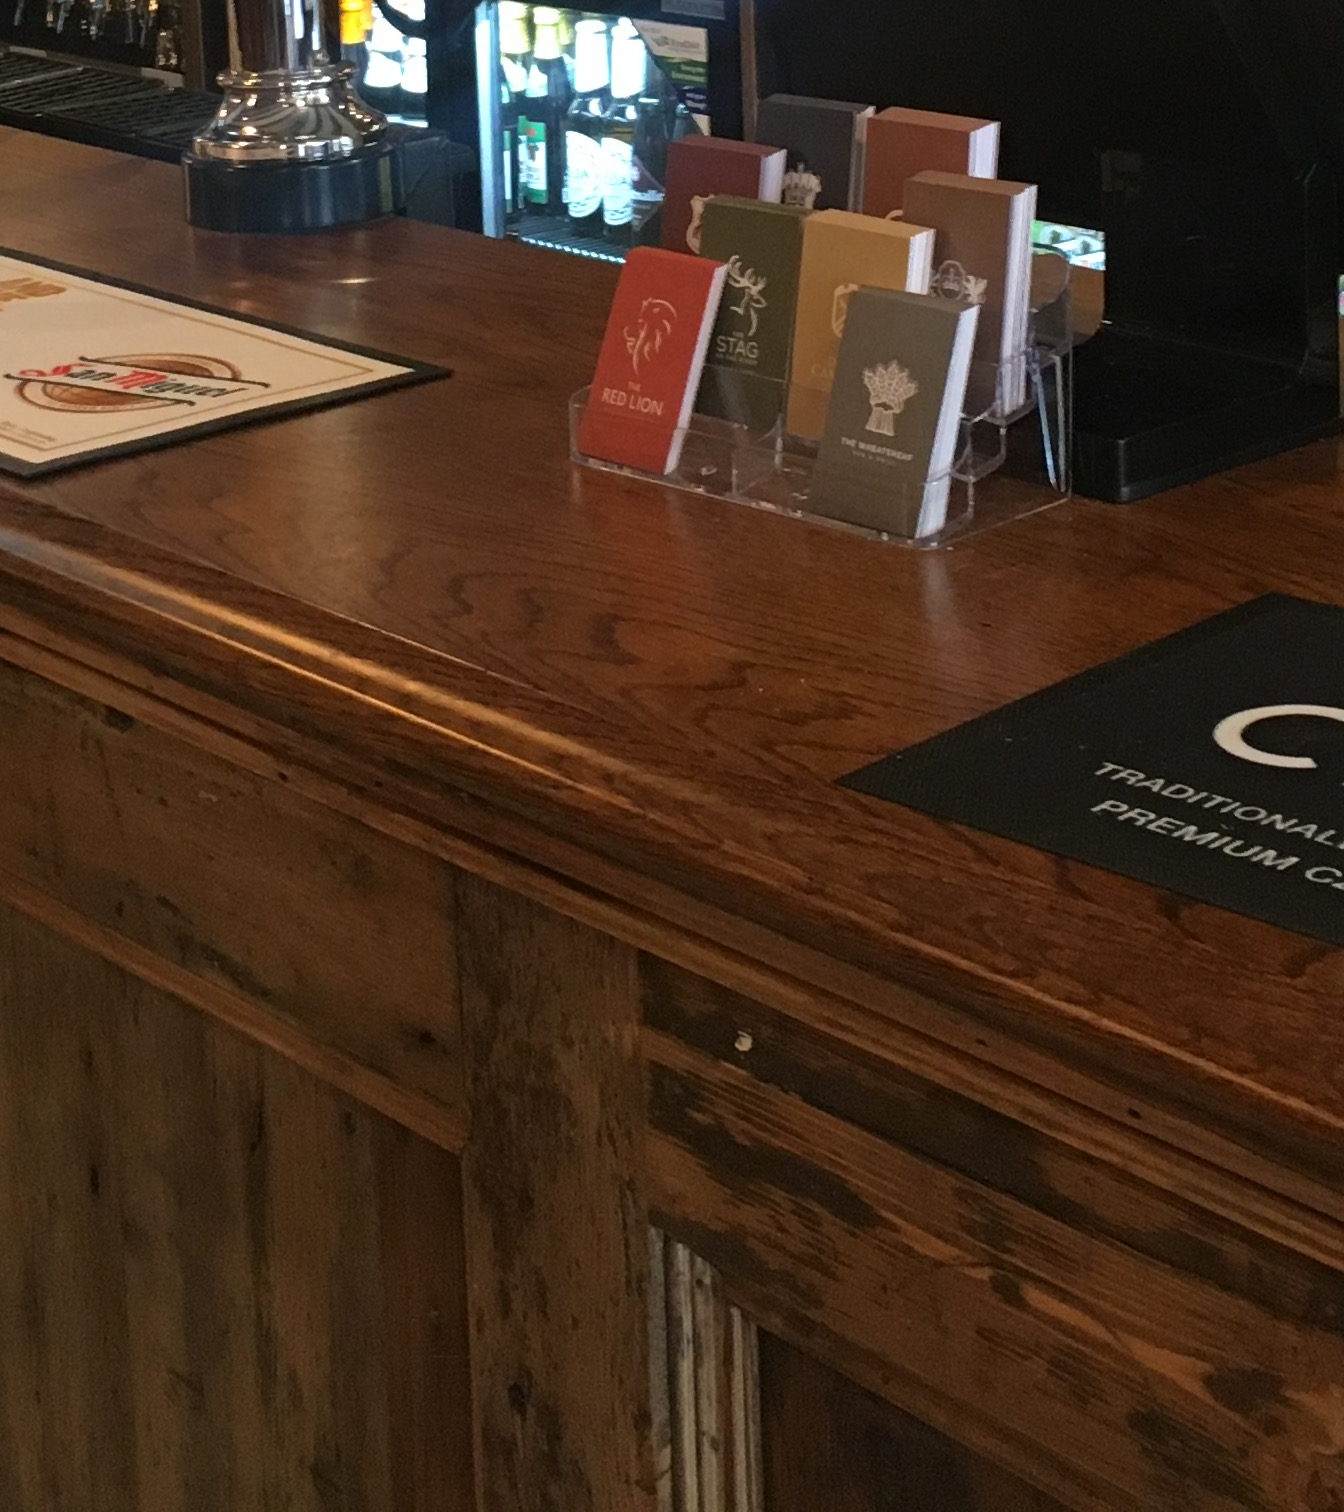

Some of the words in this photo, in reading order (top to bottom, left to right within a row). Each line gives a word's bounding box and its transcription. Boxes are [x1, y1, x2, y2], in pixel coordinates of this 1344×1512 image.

[715, 335, 759, 359] STAG
[18, 362, 118, 382] San
[106, 370, 250, 398] Miguel
[602, 387, 626, 406] RED
[628, 394, 664, 416] LION
[1090, 799, 1301, 871] PREMIUM
